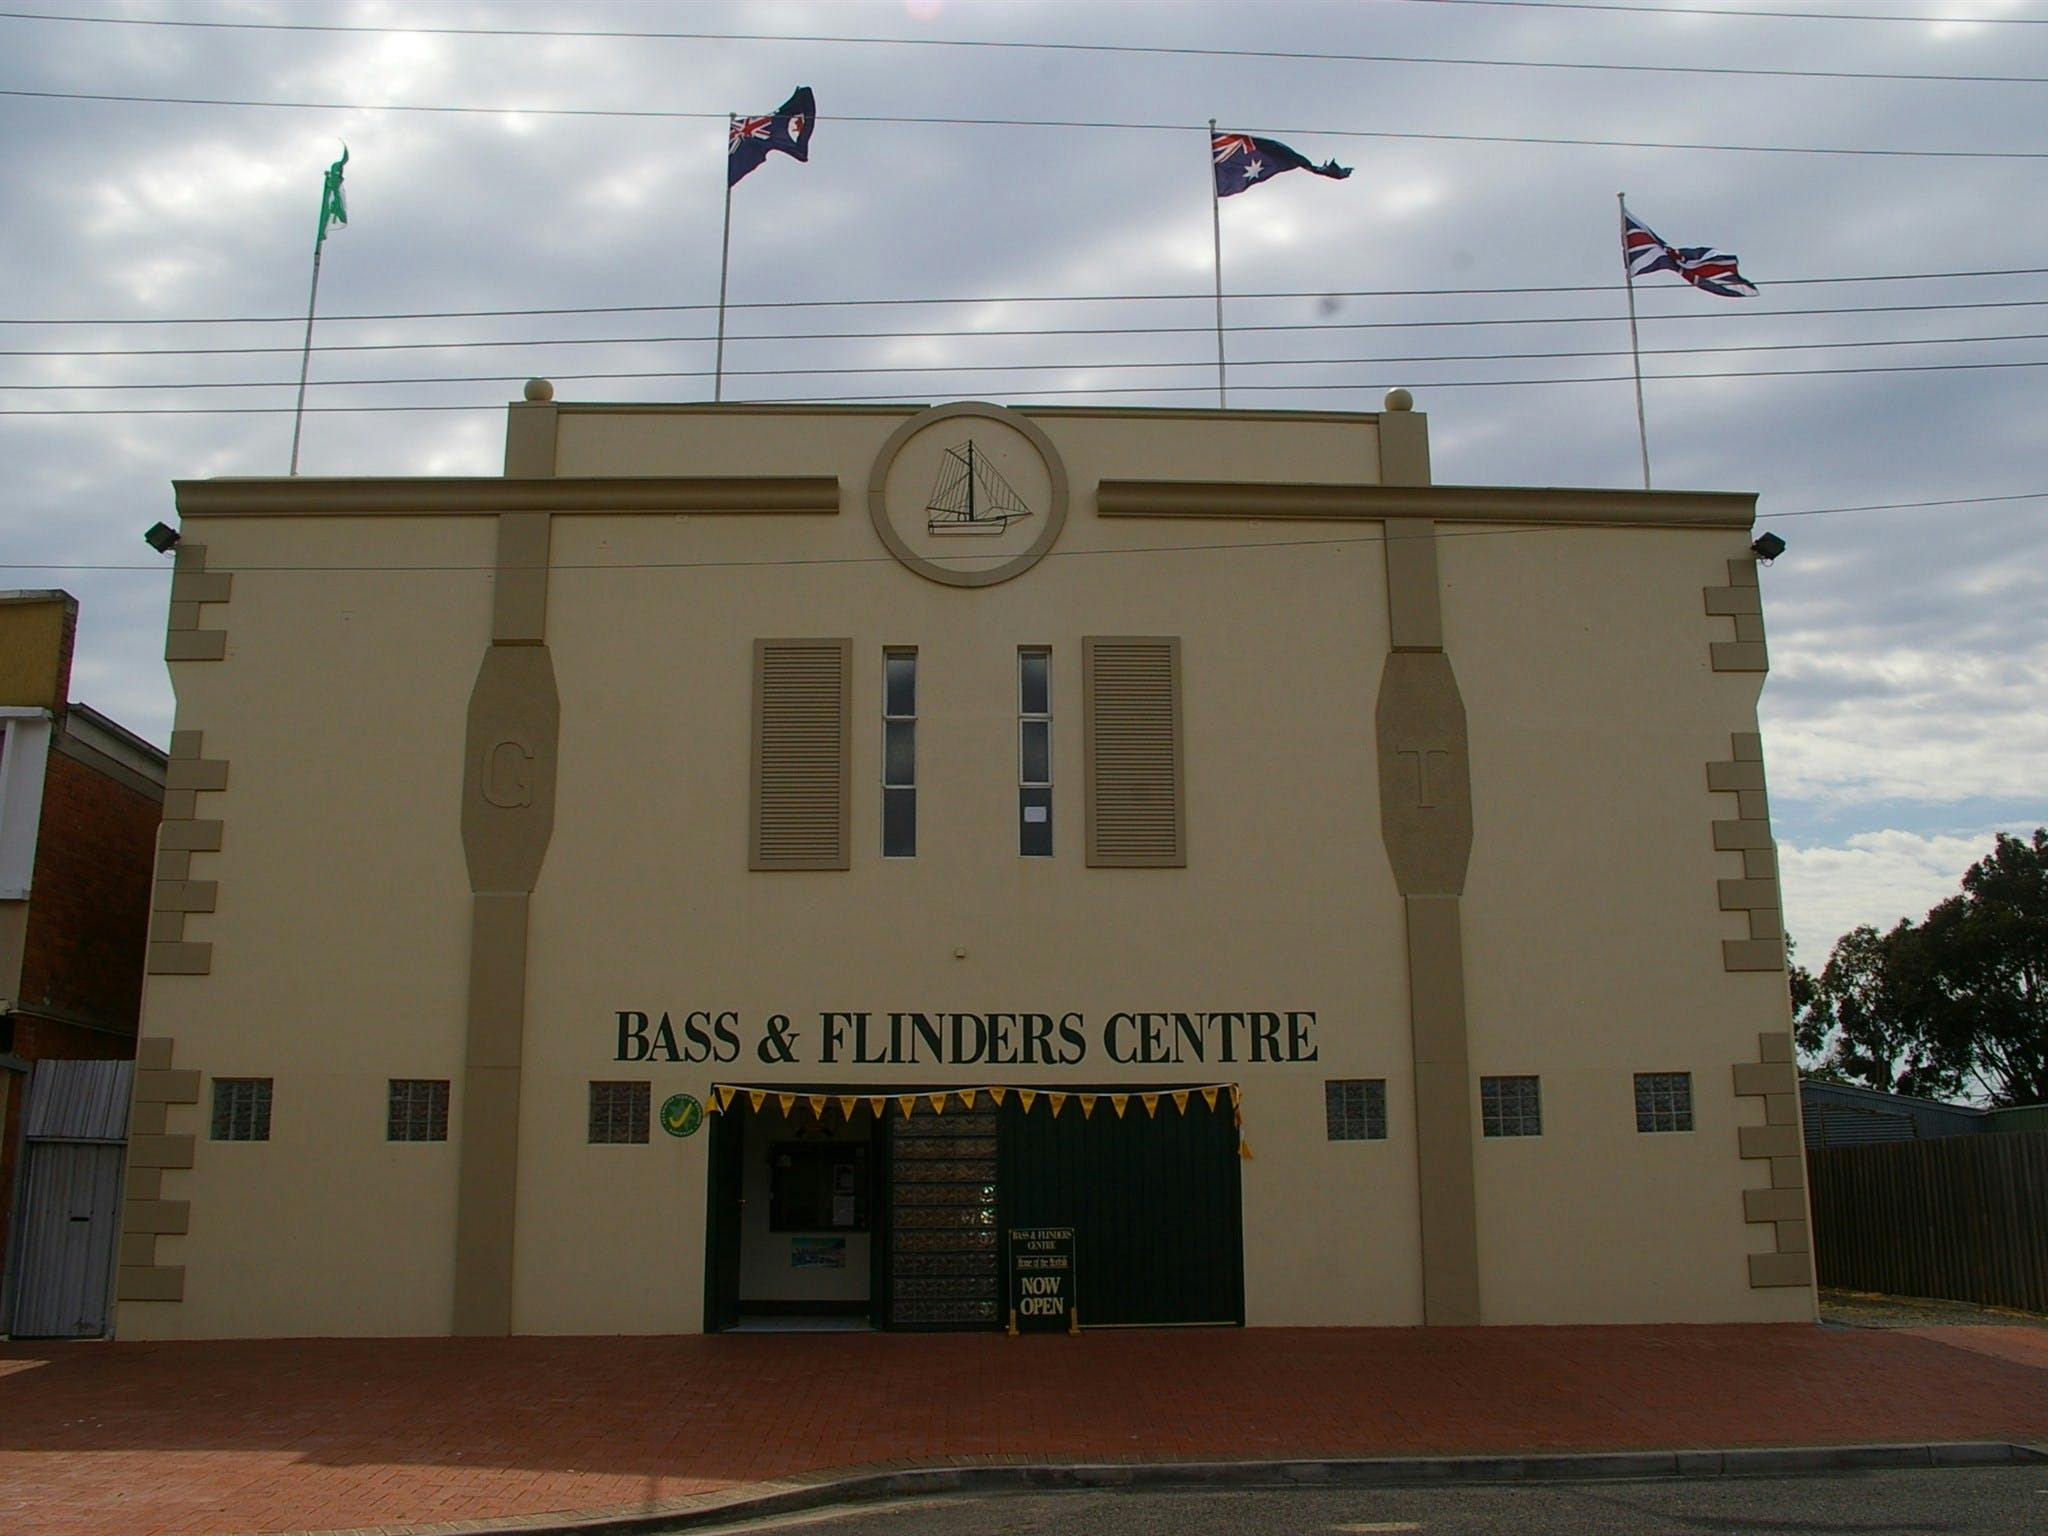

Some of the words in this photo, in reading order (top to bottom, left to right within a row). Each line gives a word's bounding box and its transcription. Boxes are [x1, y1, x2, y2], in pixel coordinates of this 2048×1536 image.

[480, 741, 535, 809] G
[1395, 745, 1448, 809] T
[612, 1010, 741, 1064] BASS
[757, 1013, 800, 1065] &
[817, 1010, 1085, 1066] FLINDERS
[1103, 1010, 1319, 1065] CENTRE
[1020, 1297, 1064, 1316] OPEN
[1021, 1277, 1061, 1296] NOW
